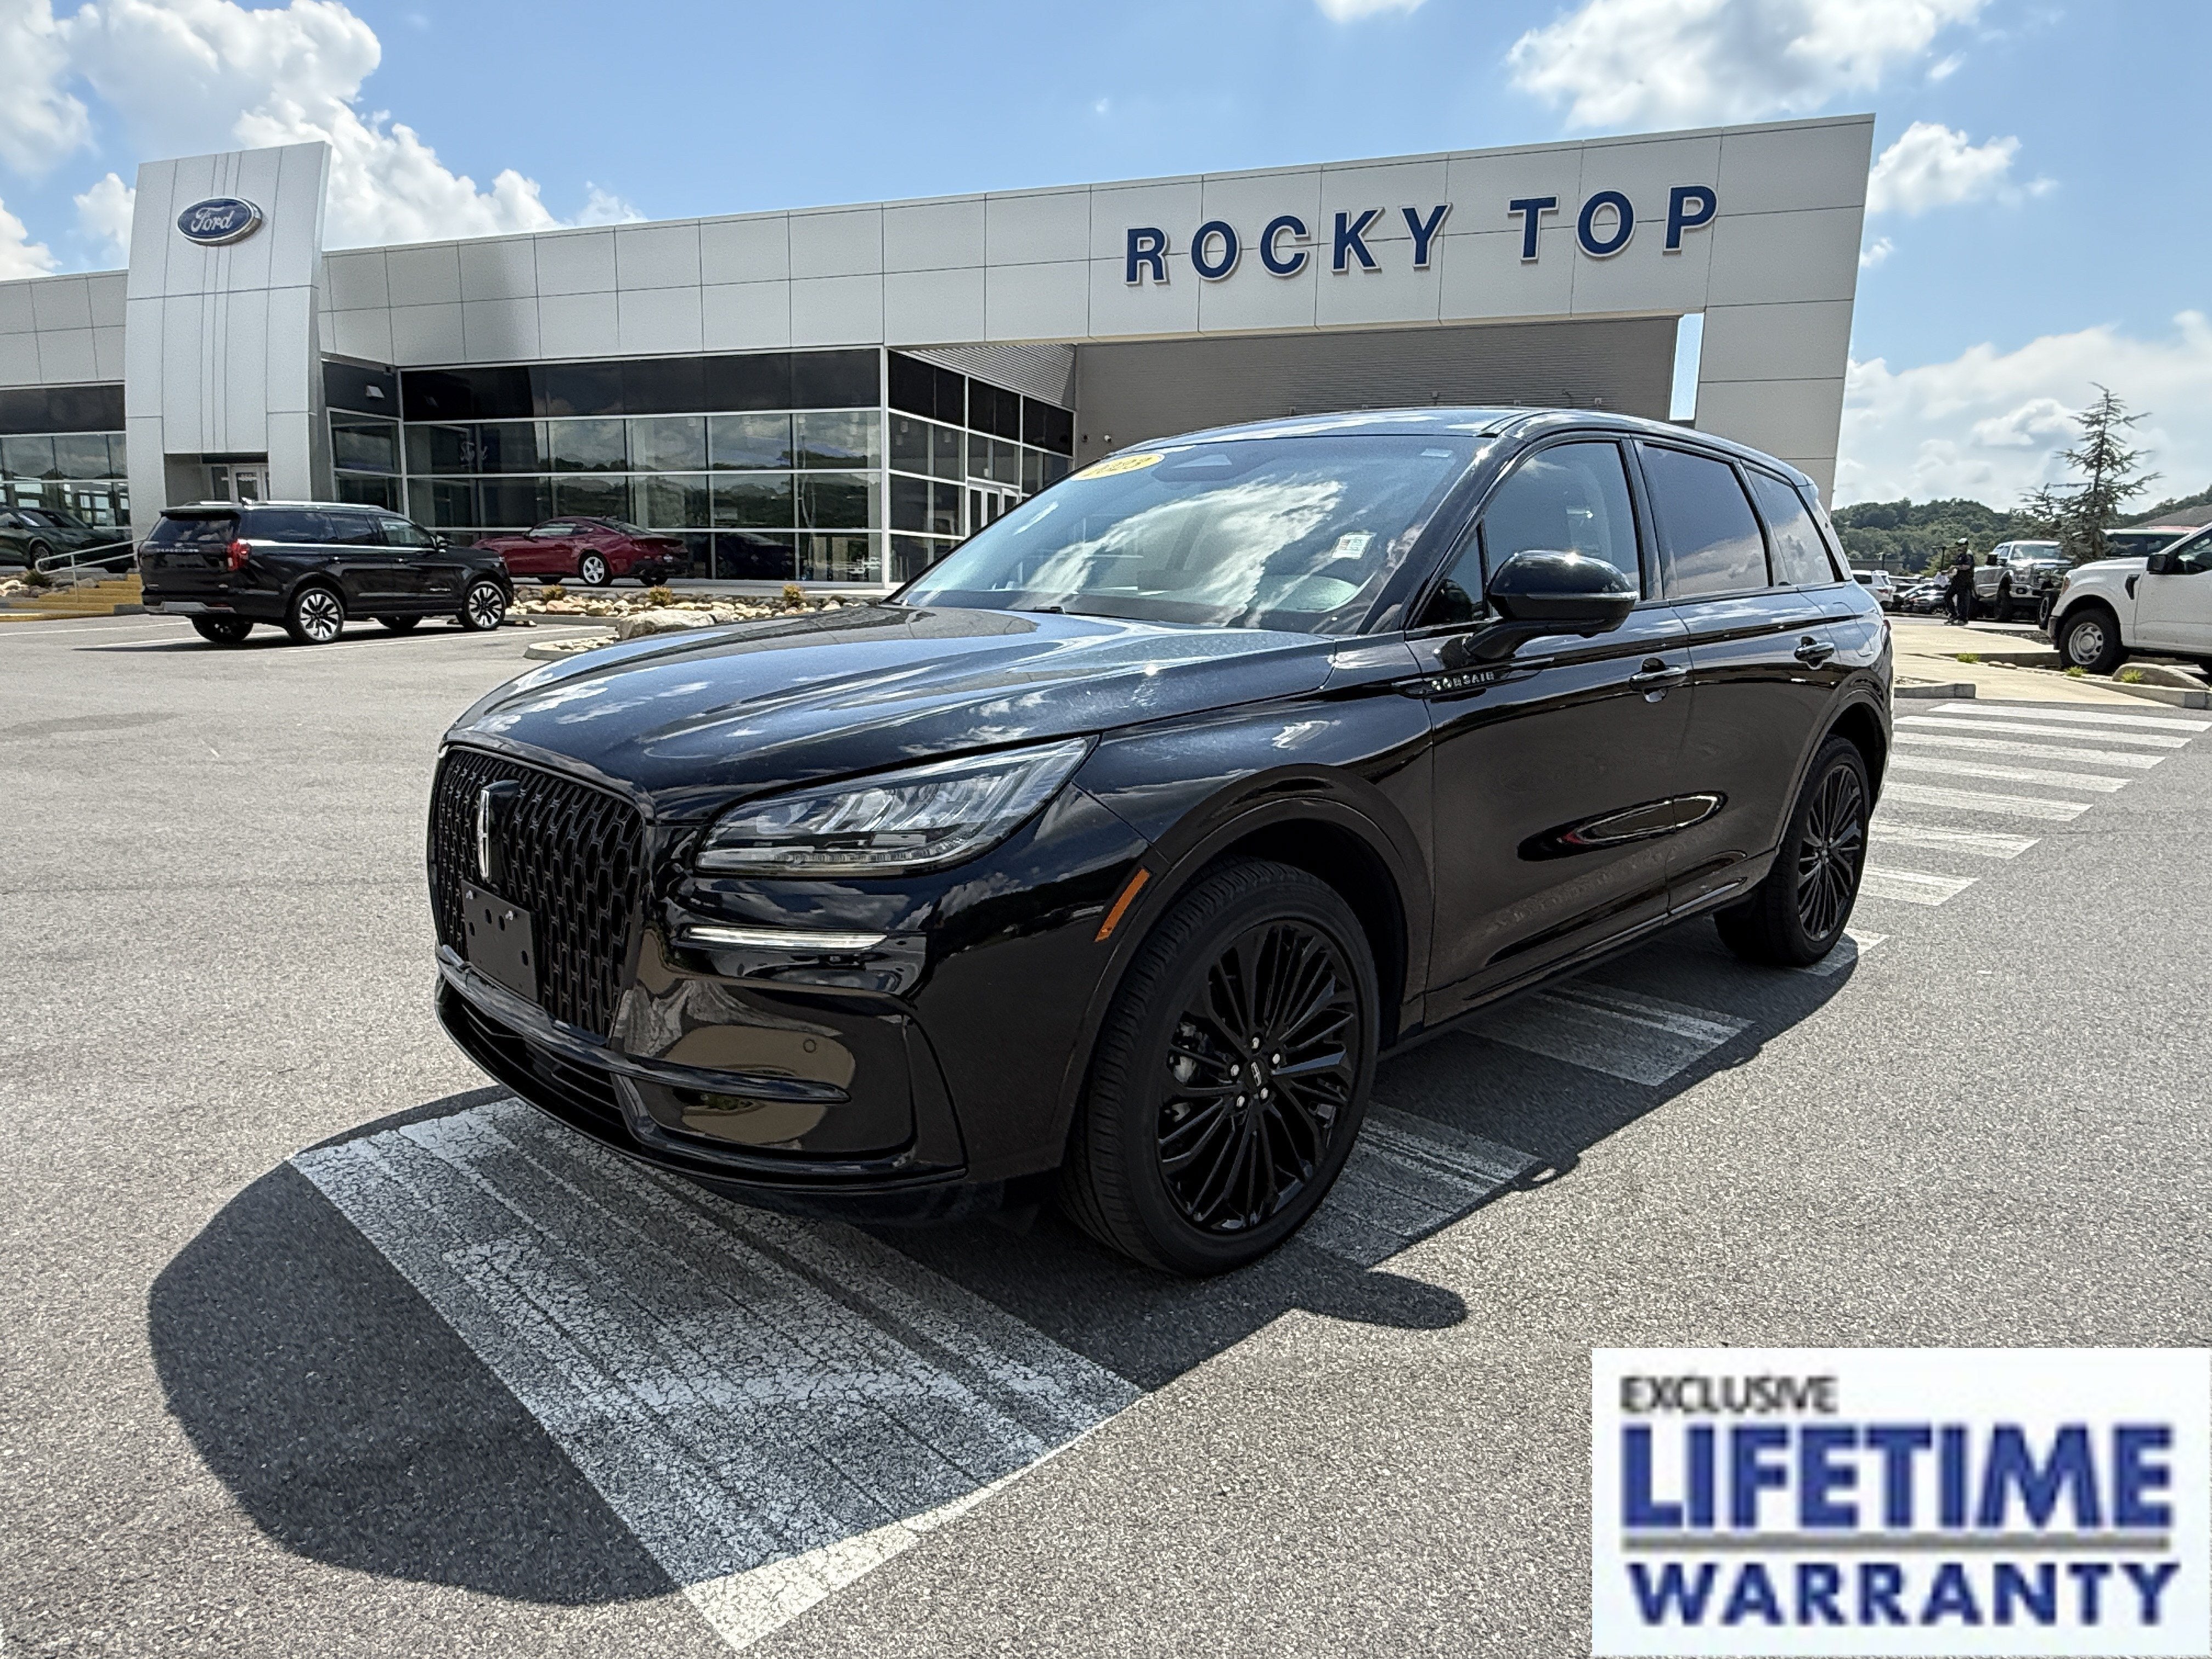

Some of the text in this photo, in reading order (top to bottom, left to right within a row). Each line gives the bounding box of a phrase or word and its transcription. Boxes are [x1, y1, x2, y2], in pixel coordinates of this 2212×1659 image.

[191, 205, 236, 233] Ford
[1126, 185, 1717, 283] ROCKY TOP
